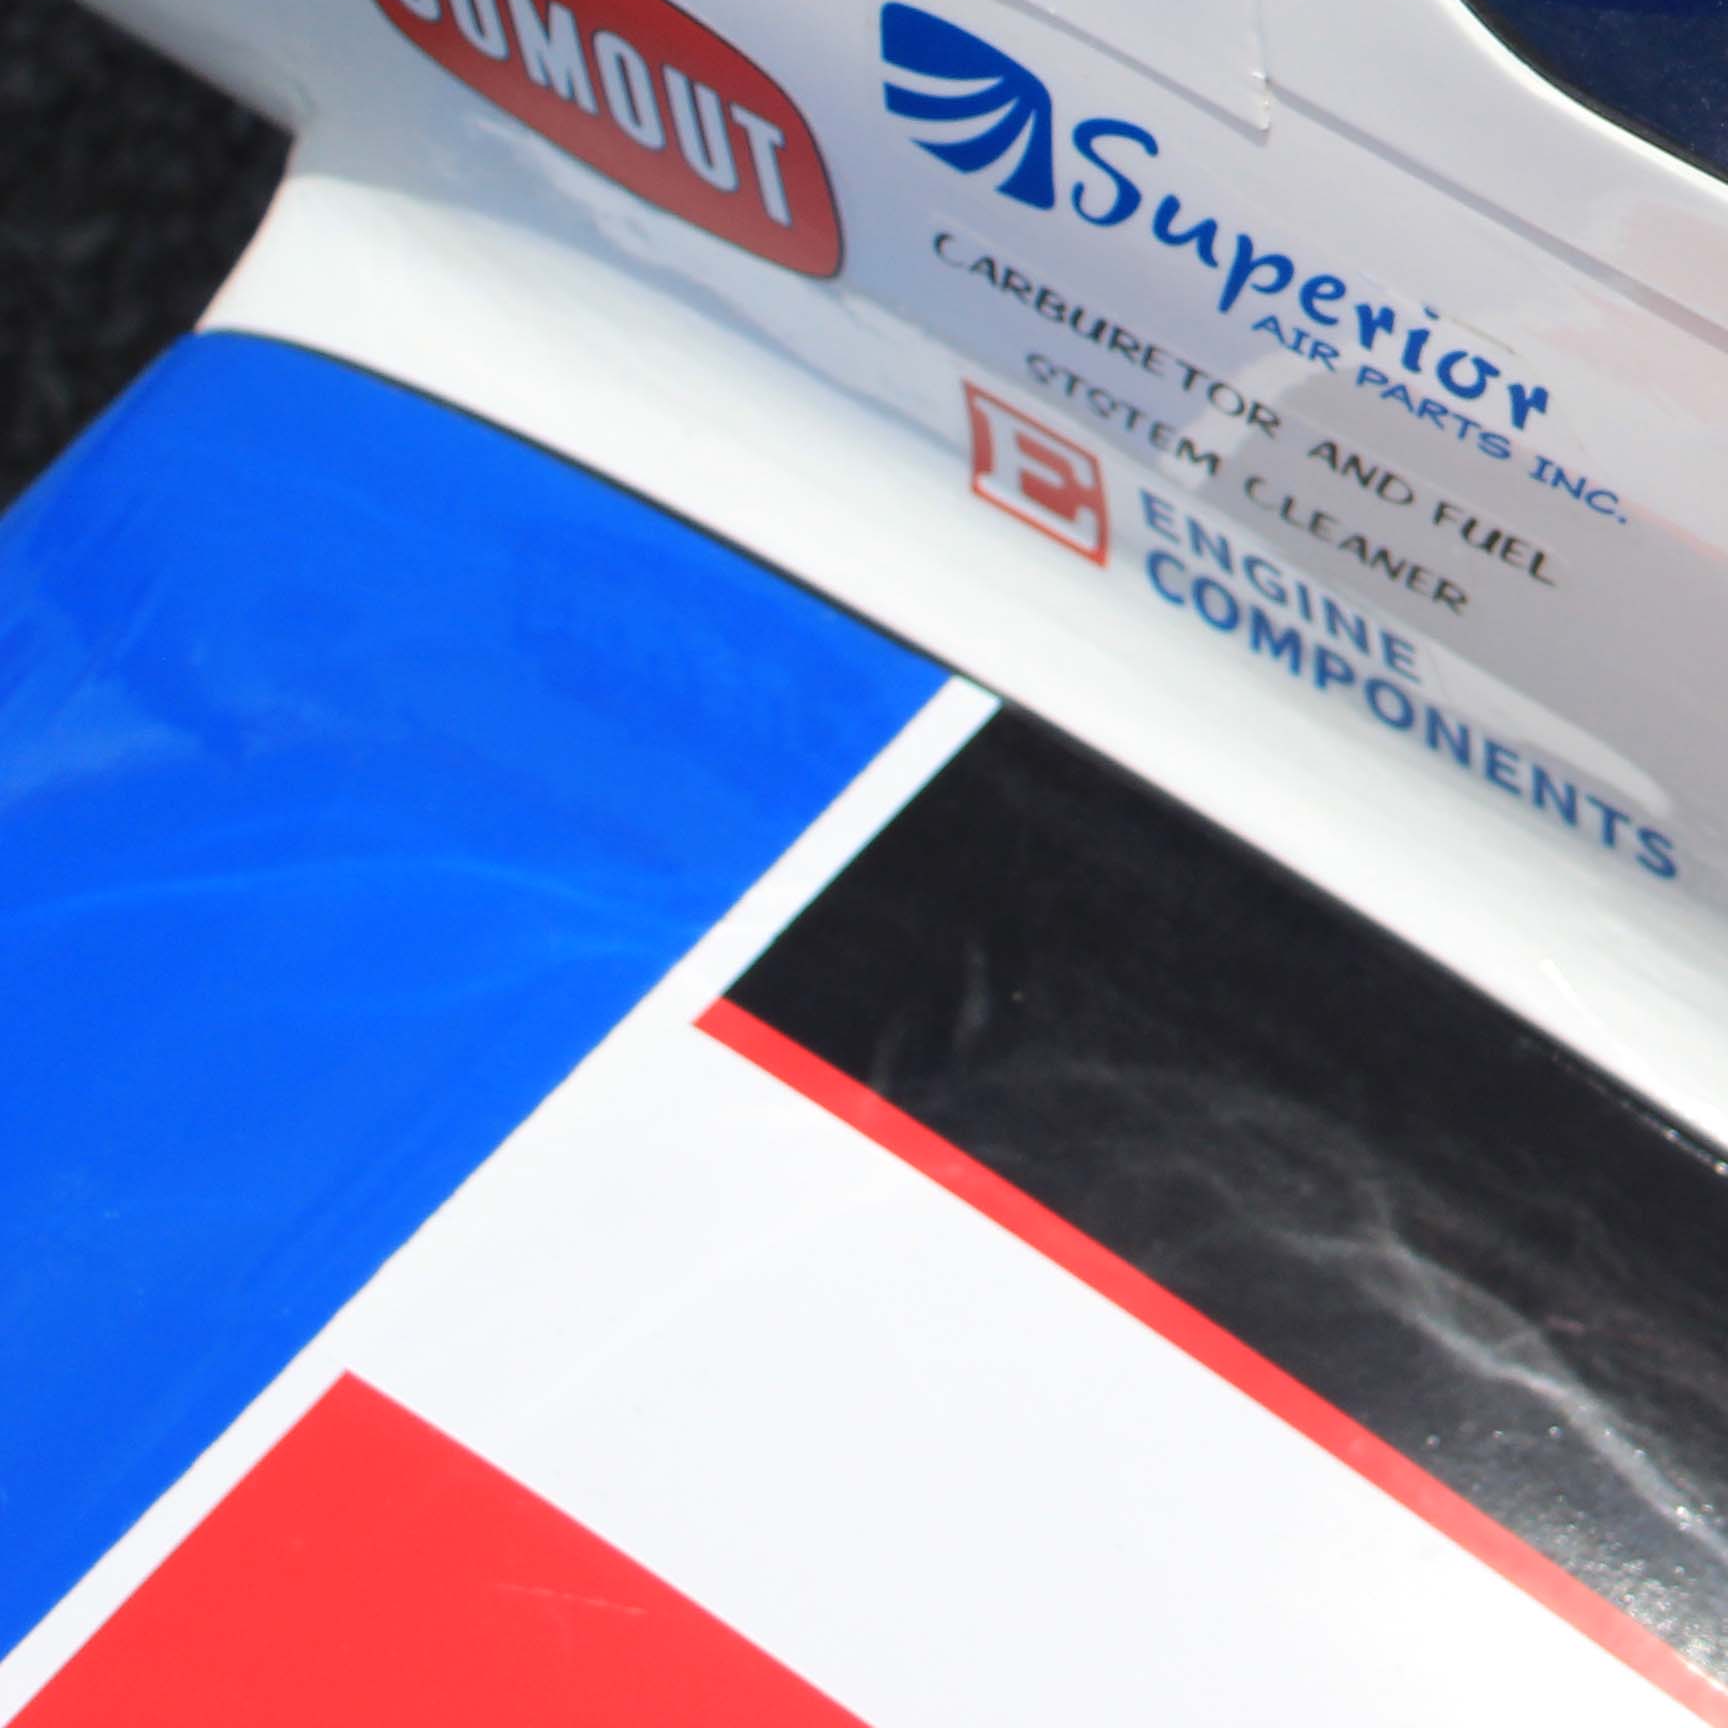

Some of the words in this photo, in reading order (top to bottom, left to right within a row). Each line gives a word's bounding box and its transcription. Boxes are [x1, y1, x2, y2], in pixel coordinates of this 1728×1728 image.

[1071, 117, 1551, 431] Superior
[932, 231, 1282, 440] CARBURETOR
[1307, 439, 1415, 509] AND
[1434, 500, 1557, 588] FUEL
[1252, 313, 1339, 373] AIR
[1357, 366, 1512, 460] PARTS
[1528, 455, 1630, 523] INC.
[1139, 487, 1419, 679] ENGINE
[1244, 476, 1471, 615] CLEANER
[1145, 548, 1679, 880] COMPONENTS
